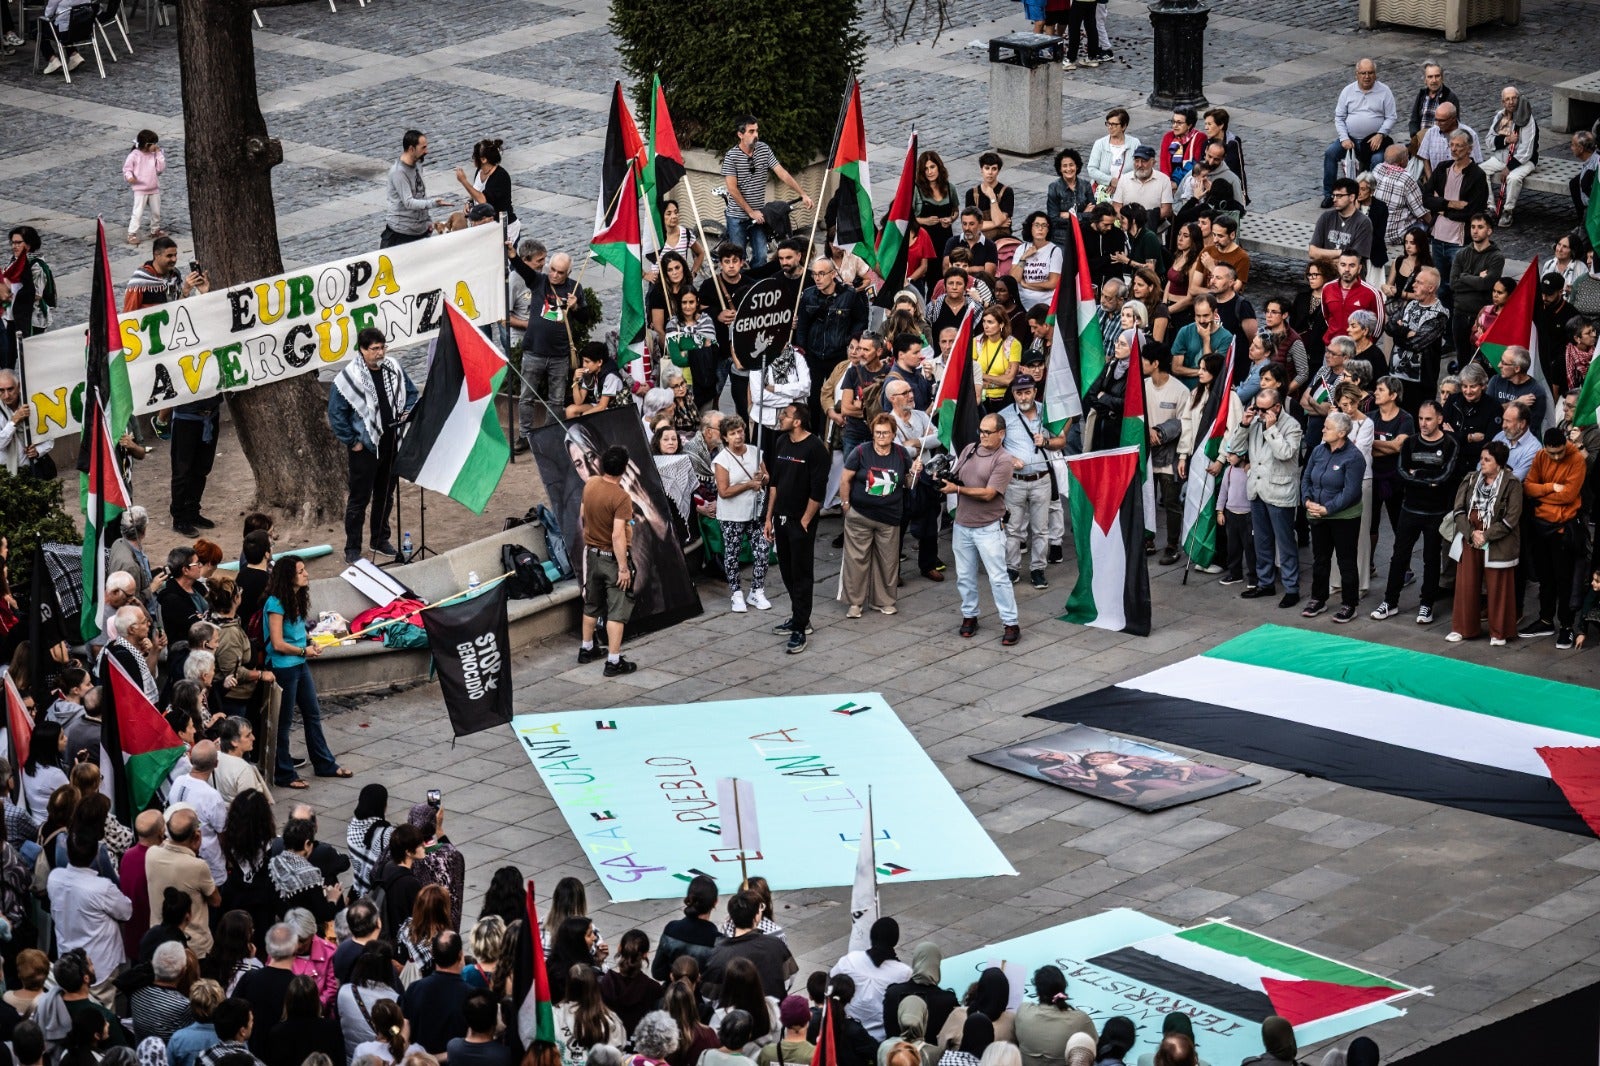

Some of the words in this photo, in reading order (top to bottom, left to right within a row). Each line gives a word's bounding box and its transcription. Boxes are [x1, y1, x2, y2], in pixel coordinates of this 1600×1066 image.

[227, 255, 400, 333] EUROPA
[735, 309, 792, 333] GENOCIDIO
[750, 289, 782, 310] STOP
[456, 641, 485, 700] GENOCIDIO
[474, 631, 501, 676] STOP
[645, 756, 721, 822] PUEBLO
[748, 728, 863, 813] LEVANTA
[586, 825, 667, 883] GAZA
